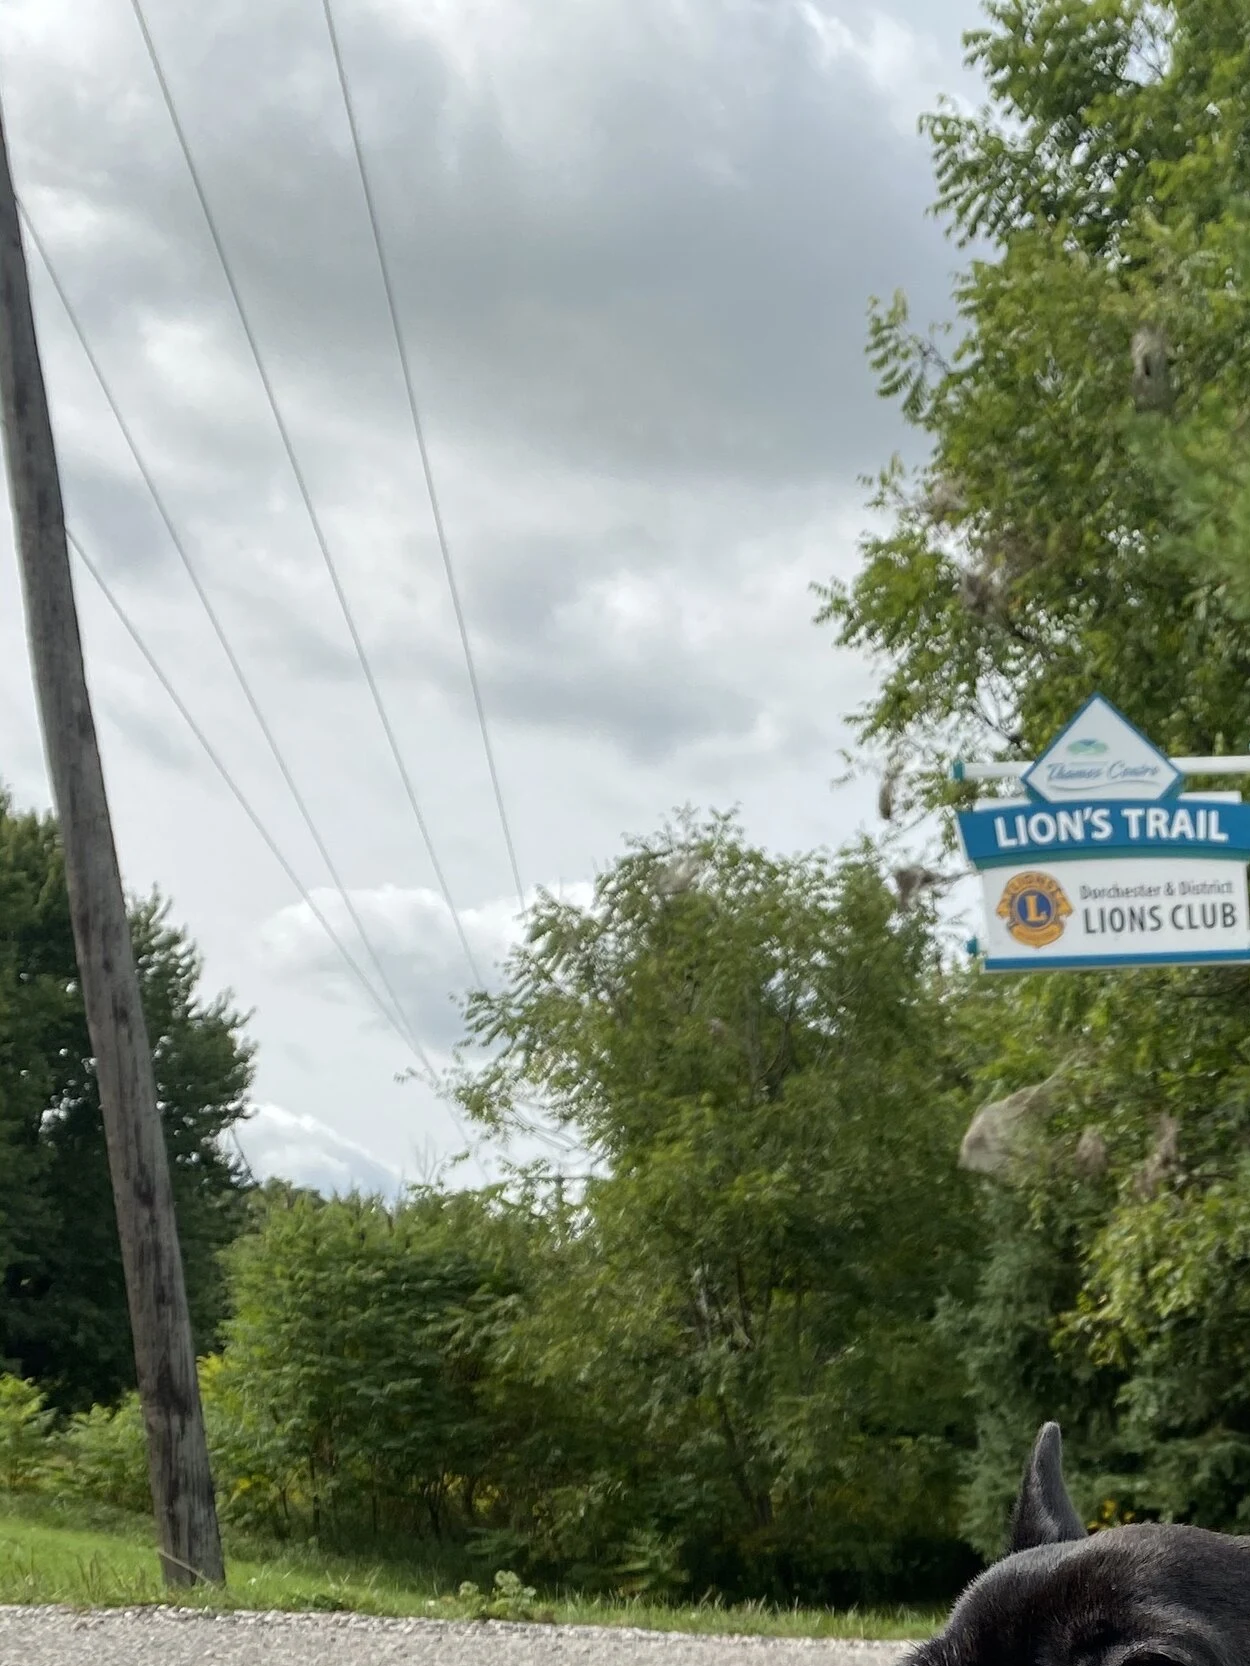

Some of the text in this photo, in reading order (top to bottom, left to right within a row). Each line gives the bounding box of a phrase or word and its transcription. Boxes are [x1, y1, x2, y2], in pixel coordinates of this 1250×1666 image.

[994, 807, 1229, 848] LION'S TRAIL
[1079, 880, 1233, 899] Dorchester & District
[1026, 895, 1048, 922] L
[1084, 904, 1163, 934] LIONS
[1171, 902, 1237, 930] CLUB
